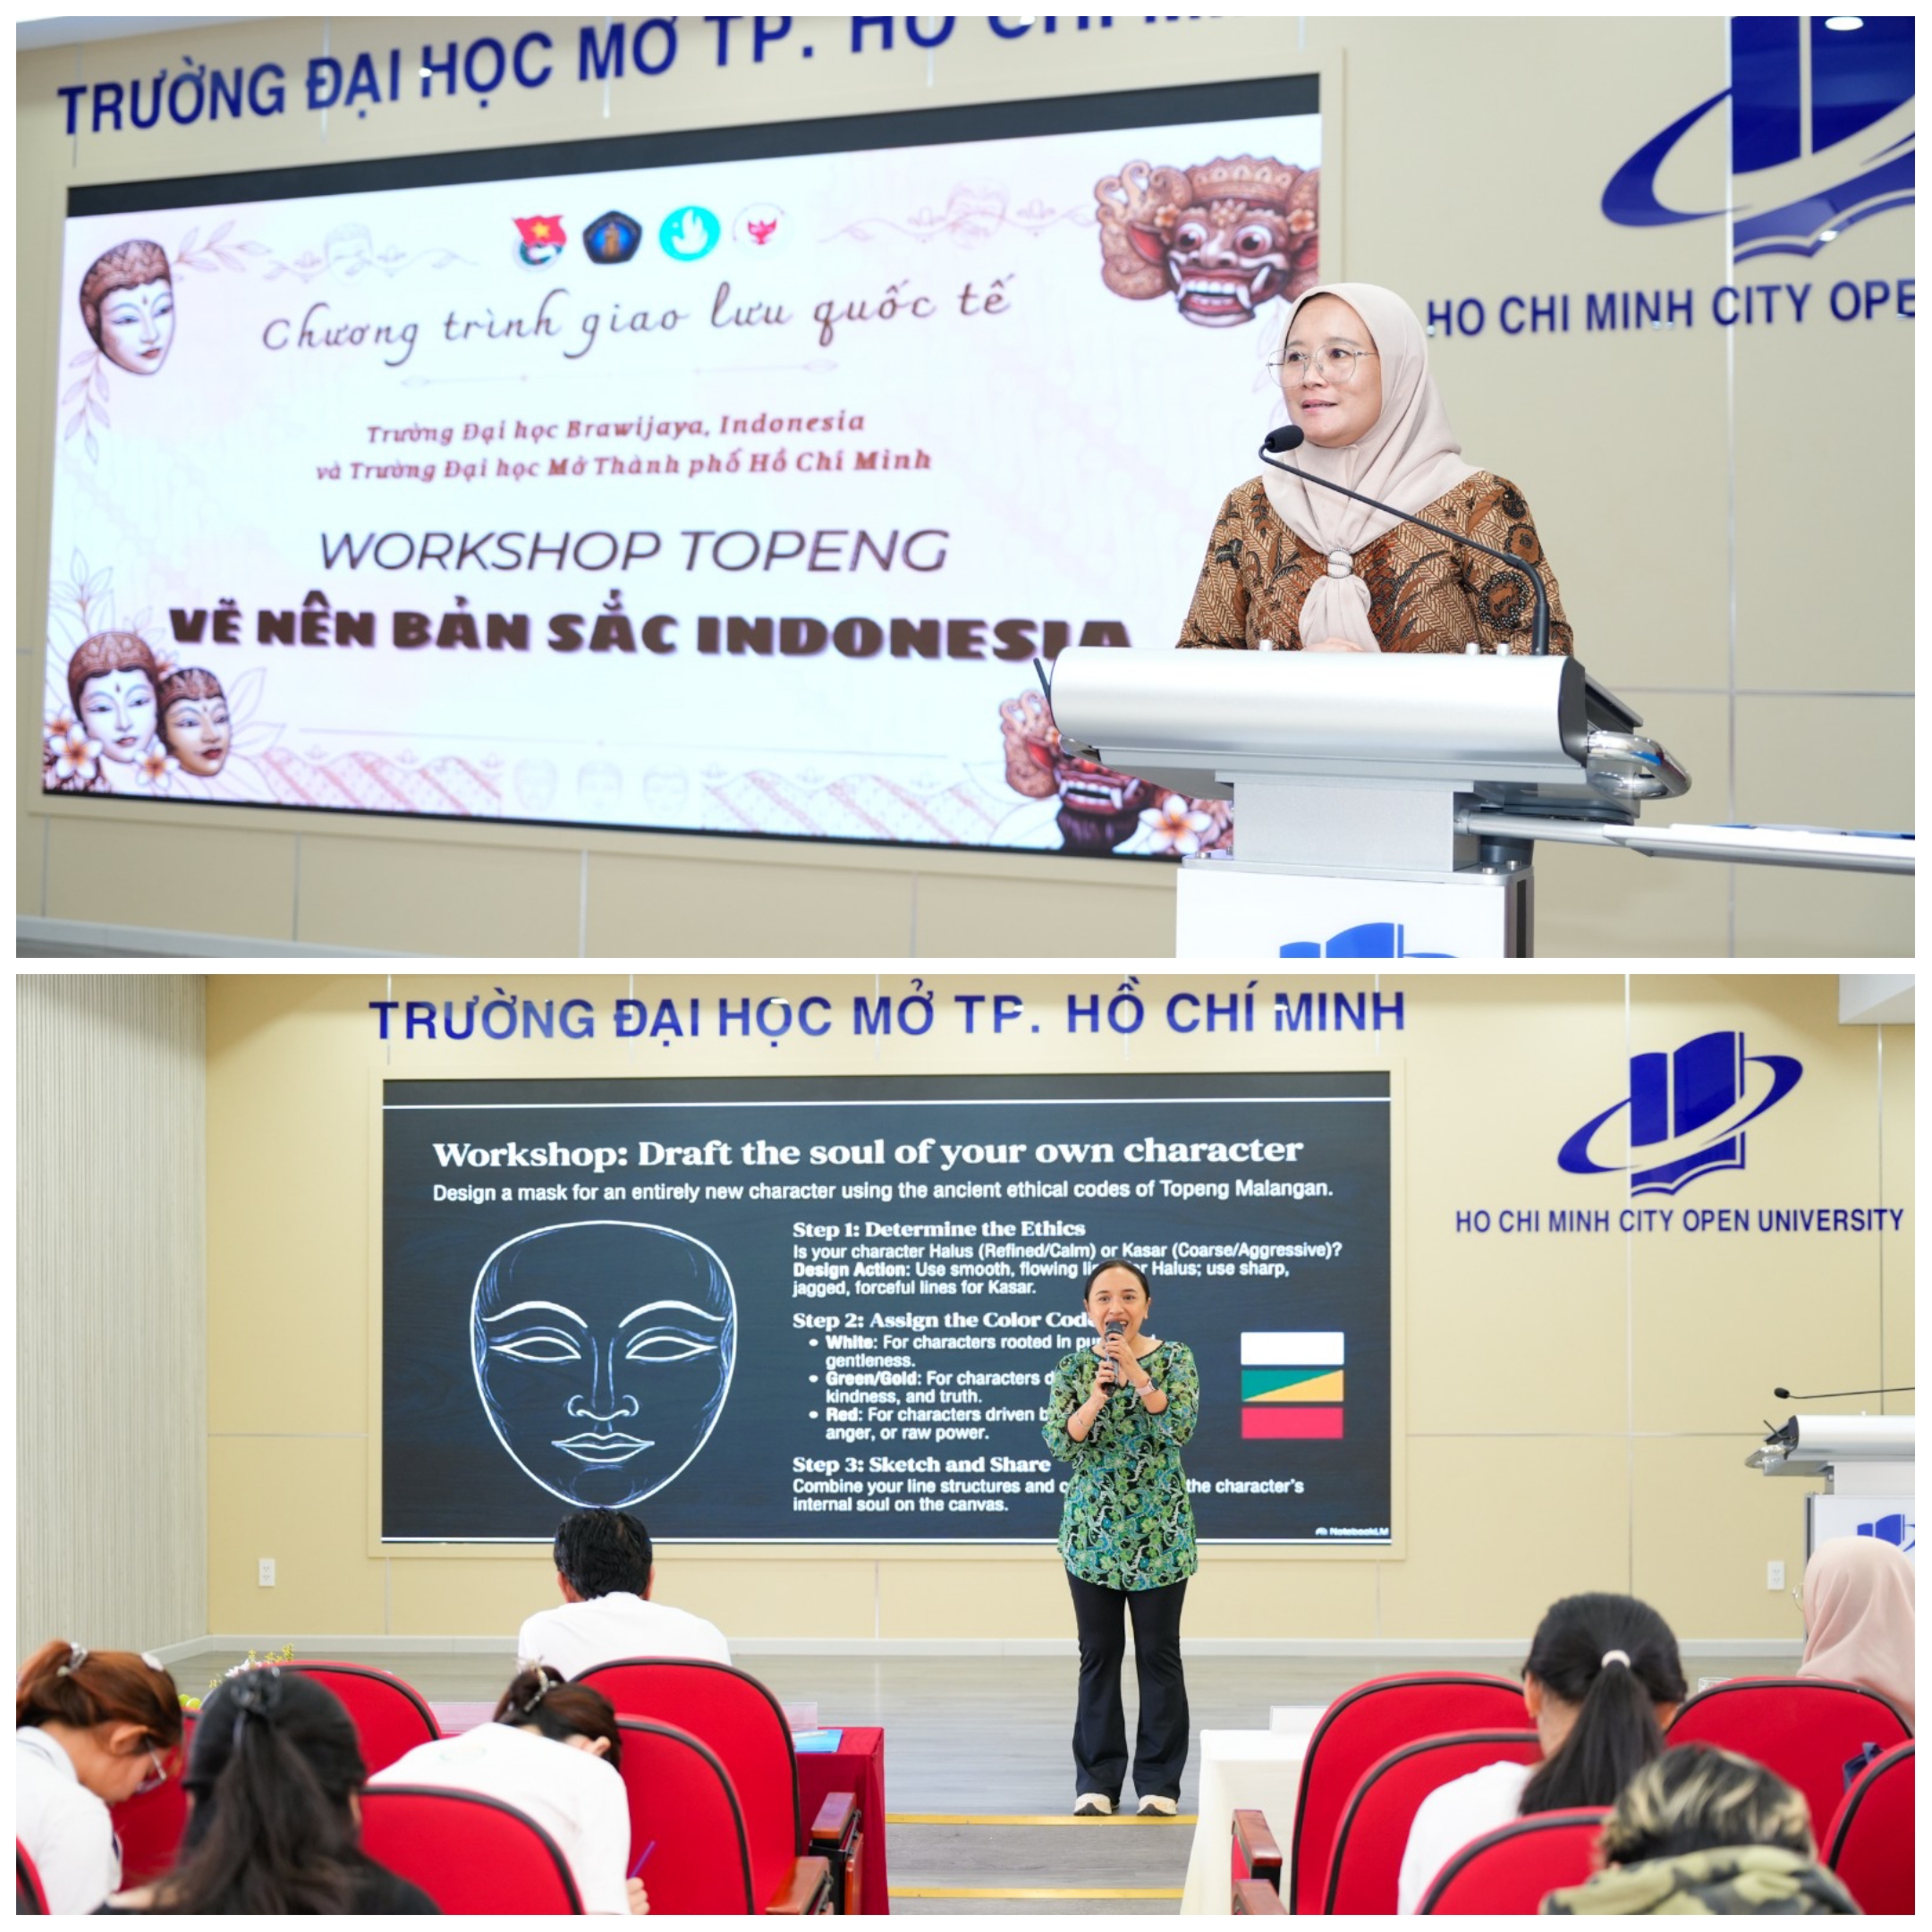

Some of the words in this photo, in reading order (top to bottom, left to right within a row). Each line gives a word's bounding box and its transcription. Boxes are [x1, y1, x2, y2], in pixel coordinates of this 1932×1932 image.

[56, 55, 286, 136] TRƯỜNG
[305, 48, 401, 119] ĐẠI
[420, 31, 555, 109] HỌC
[703, 16, 815, 67] TP.
[1428, 298, 1485, 336] HO
[1499, 293, 1570, 335] CHI
[1586, 289, 1694, 331] MINH
[1712, 283, 1812, 327] CITY
[1831, 278, 1915, 321] OPE
[262, 301, 419, 368] Chương
[443, 286, 564, 342] trình
[563, 301, 683, 360] giao
[710, 280, 793, 329] lưu
[812, 278, 937, 348] quốc
[957, 273, 1017, 317] tế
[367, 423, 454, 446] Trường
[462, 419, 505, 445] Đại
[513, 419, 558, 445] học
[566, 415, 710, 442] Brawijaya,
[719, 409, 865, 435] Indonesia
[316, 463, 342, 480] và
[350, 462, 436, 483] Trường
[444, 458, 487, 482] Đại
[496, 458, 539, 481] học
[547, 456, 588, 476] Mở
[593, 454, 680, 476] Thành
[688, 448, 742, 479] phố
[795, 449, 844, 472] Chí
[853, 448, 932, 471] Minh
[321, 531, 662, 572] WORKSHOP
[681, 529, 949, 572] TOPENG
[169, 597, 242, 644] VẼ
[257, 589, 376, 647] NÊN
[393, 596, 530, 650] BẢN
[547, 588, 678, 655] SẮC
[698, 616, 1132, 661] INDONESIA
[370, 987, 596, 1041] TRƯỜNG
[613, 998, 699, 1047] ĐẠI
[718, 996, 832, 1046] HỌC
[852, 978, 935, 1037] MỞ
[955, 996, 1039, 1033] TP.
[1067, 975, 1146, 1035] HỒ
[1165, 981, 1256, 1034] CHÍ
[1275, 991, 1405, 1032] MINH
[433, 1141, 628, 1174] Workshop:
[638, 1140, 733, 1166] Draft
[740, 1140, 801, 1165] the
[809, 1139, 886, 1165] soul
[894, 1138, 936, 1165] of
[939, 1143, 1028, 1172] your
[1035, 1143, 1115, 1164] own
[1123, 1136, 1305, 1163] character
[433, 1184, 496, 1205] Design
[501, 1187, 513, 1201] a
[517, 1183, 568, 1201] mask
[572, 1182, 600, 1201] for
[603, 1186, 626, 1201] an
[631, 1182, 701, 1204] entirely
[705, 1185, 744, 1200] new
[749, 1182, 837, 1200] character
[841, 1181, 893, 1202] using
[897, 1181, 928, 1199] the
[932, 1181, 1003, 1199] ancient
[1006, 1180, 1069, 1199] ethical
[1072, 1179, 1131, 1198] codes
[1135, 1179, 1156, 1198] of
[1158, 1179, 1230, 1200] Topeng
[1235, 1178, 1334, 1200] Malangan.
[792, 1221, 841, 1241] Step
[843, 1222, 860, 1238] 1:
[864, 1220, 978, 1238] Determine
[980, 1220, 1017, 1237] the
[1021, 1219, 1087, 1237] Ethics
[1456, 1209, 1491, 1233] HO
[1498, 1209, 1539, 1233] CHI
[1548, 1210, 1609, 1232] MINH
[1620, 1208, 1673, 1233] CITY
[1682, 1208, 1750, 1232] OPEN
[1758, 1208, 1903, 1233] UNIVERSITY
[792, 1243, 808, 1259] Is
[810, 1246, 848, 1260] your
[851, 1243, 926, 1259] character
[929, 1242, 974, 1259] Halus
[978, 1241, 1097, 1260] (Refined/Calm)
[1100, 1245, 1119, 1258] or
[1122, 1241, 1168, 1258] Kasar
[1171, 1241, 1343, 1260] (Coarse/Aggressive)?
[792, 1261, 850, 1279] Design
[852, 1261, 911, 1277] Action:
[915, 1261, 946, 1277] Use
[949, 1260, 1015, 1278] smooth,
[1019, 1260, 1079, 1280] flowing
[1151, 1259, 1202, 1277] Halus;
[1206, 1262, 1236, 1276] use
[1239, 1259, 1290, 1279] sharp,
[792, 1280, 851, 1299] jagged,
[854, 1279, 916, 1295] forceful
[919, 1279, 958, 1295] lines
[960, 1279, 985, 1295] for
[987, 1279, 1037, 1295] Kasar.
[792, 1312, 841, 1333] Step
[844, 1312, 865, 1328] 2:
[869, 1311, 939, 1332] Assign
[943, 1311, 979, 1328] the
[982, 1311, 1043, 1328] Color
[825, 1334, 878, 1350] White:
[883, 1334, 910, 1350] For
[912, 1334, 996, 1350] characters
[1000, 1334, 1053, 1350] rooted
[1056, 1334, 1072, 1349] in
[825, 1352, 916, 1370] gentleness.
[825, 1369, 922, 1386] Green/Gold:
[926, 1369, 953, 1386] For
[956, 1369, 1041, 1386] characters
[826, 1388, 902, 1406] kindness,
[905, 1388, 936, 1404] and
[939, 1388, 983, 1404] truth.
[826, 1406, 863, 1422] Red:
[868, 1406, 894, 1422] For
[897, 1406, 982, 1422] characters
[985, 1406, 1036, 1422] driven
[825, 1427, 876, 1444] anger,
[879, 1428, 898, 1441] or
[902, 1427, 932, 1440] raw
[935, 1427, 990, 1444] power.
[792, 1456, 841, 1477] Step
[844, 1457, 865, 1473] 3:
[869, 1456, 941, 1473] Sketch
[945, 1455, 986, 1473] and
[989, 1456, 1052, 1473] Share
[792, 1478, 864, 1494] Combine
[867, 1480, 904, 1496] your
[907, 1478, 936, 1494] line
[940, 1479, 1021, 1494] structures
[1024, 1478, 1055, 1494] and
[1186, 1479, 1211, 1494] the
[792, 1496, 852, 1512] internal
[856, 1496, 890, 1512] soul
[894, 1499, 915, 1512] on
[919, 1496, 945, 1512] the
[948, 1499, 1009, 1512] canvas.
